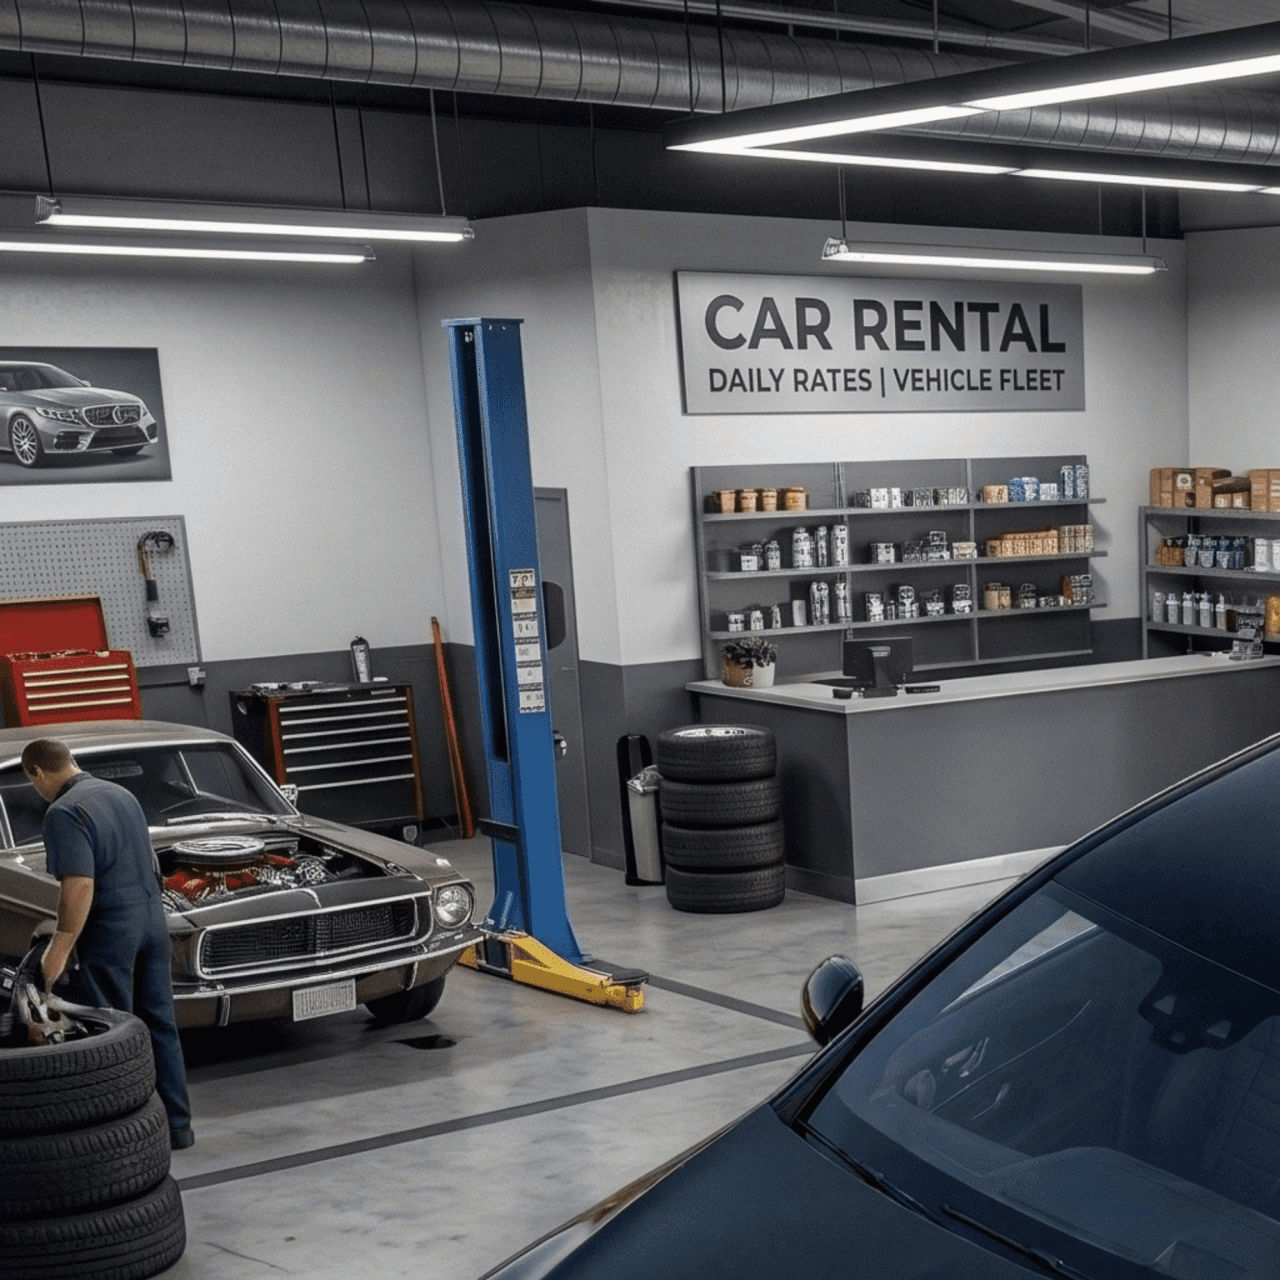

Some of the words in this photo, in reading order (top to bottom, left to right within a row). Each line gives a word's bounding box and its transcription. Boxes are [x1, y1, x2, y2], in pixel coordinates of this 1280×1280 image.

[704, 294, 833, 351] CAR
[852, 298, 1067, 353] RENTAL
[708, 368, 786, 393] DAILY
[793, 368, 872, 392] RATES
[893, 368, 993, 392] VEHICLE
[999, 369, 1066, 391] FLEET
